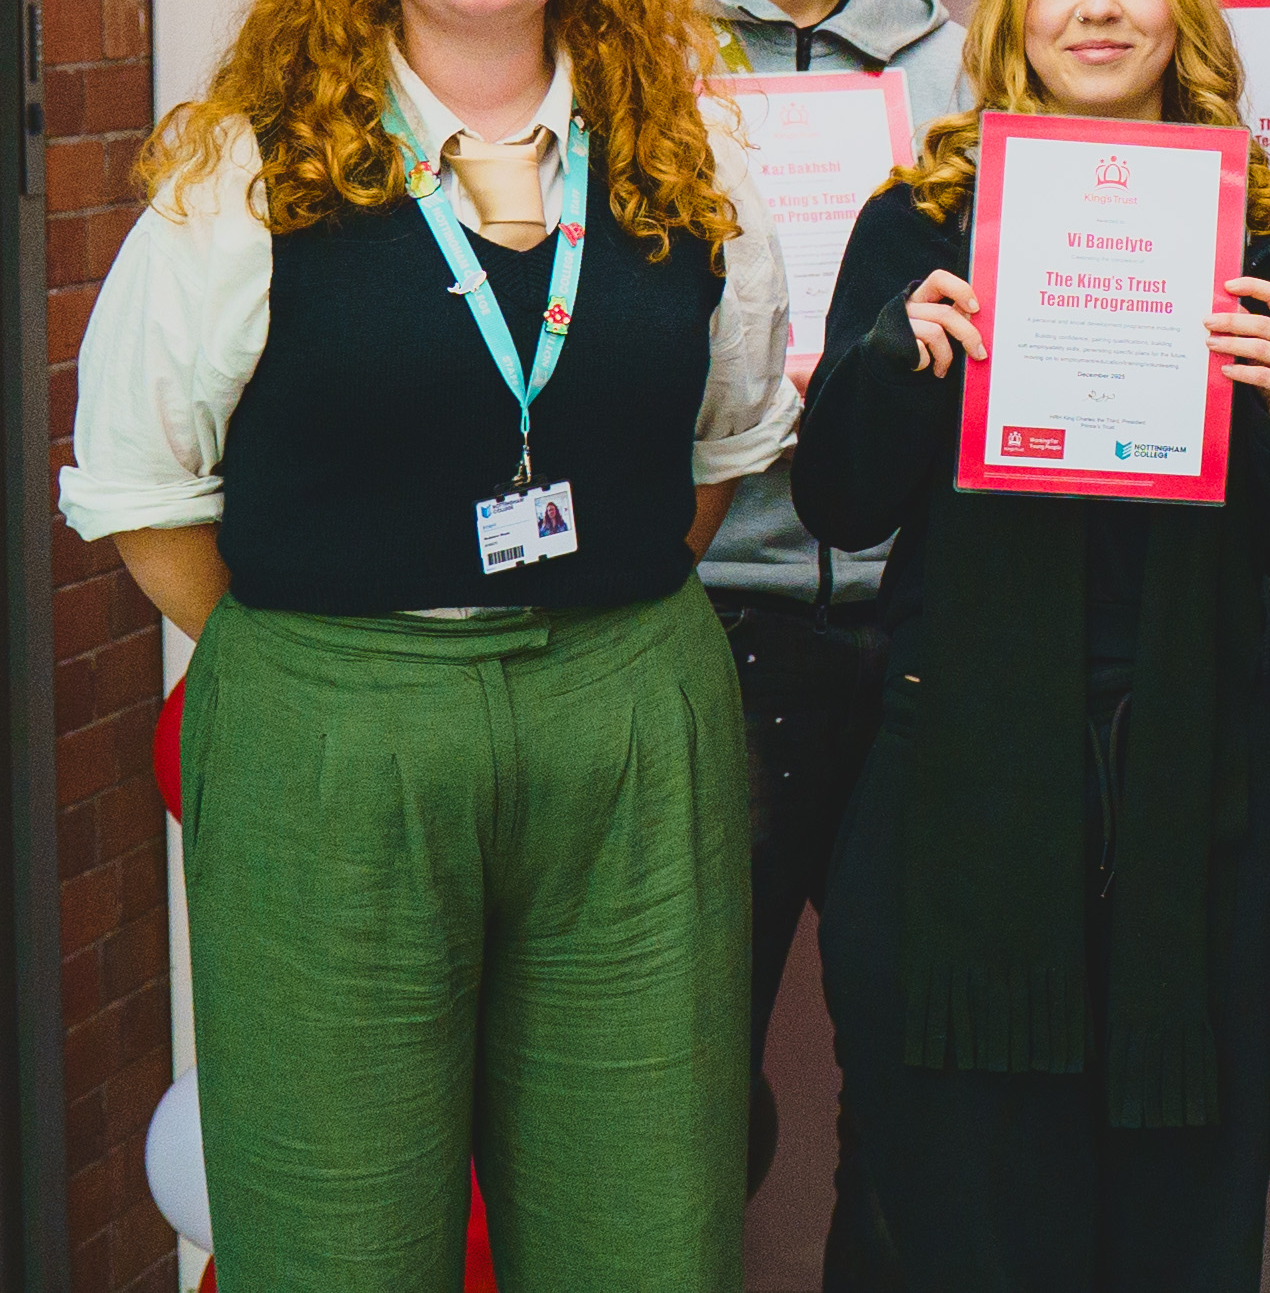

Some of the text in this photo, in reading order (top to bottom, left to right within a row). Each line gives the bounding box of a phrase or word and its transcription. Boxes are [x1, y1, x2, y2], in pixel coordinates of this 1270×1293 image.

[787, 160, 841, 175] Bakhshi
[569, 188, 581, 216] STAFF
[822, 192, 856, 205] Trust
[1113, 194, 1138, 205] Trust
[788, 209, 858, 223] Programm
[1067, 232, 1153, 253] Vi Banelyte
[558, 249, 575, 295] COLLEGE
[1046, 271, 1167, 294] The King's Trust
[1039, 290, 1174, 314] Team Programme
[1134, 443, 1187, 453] NOTTINGHAM
[1134, 451, 1168, 459] COLLEGE
